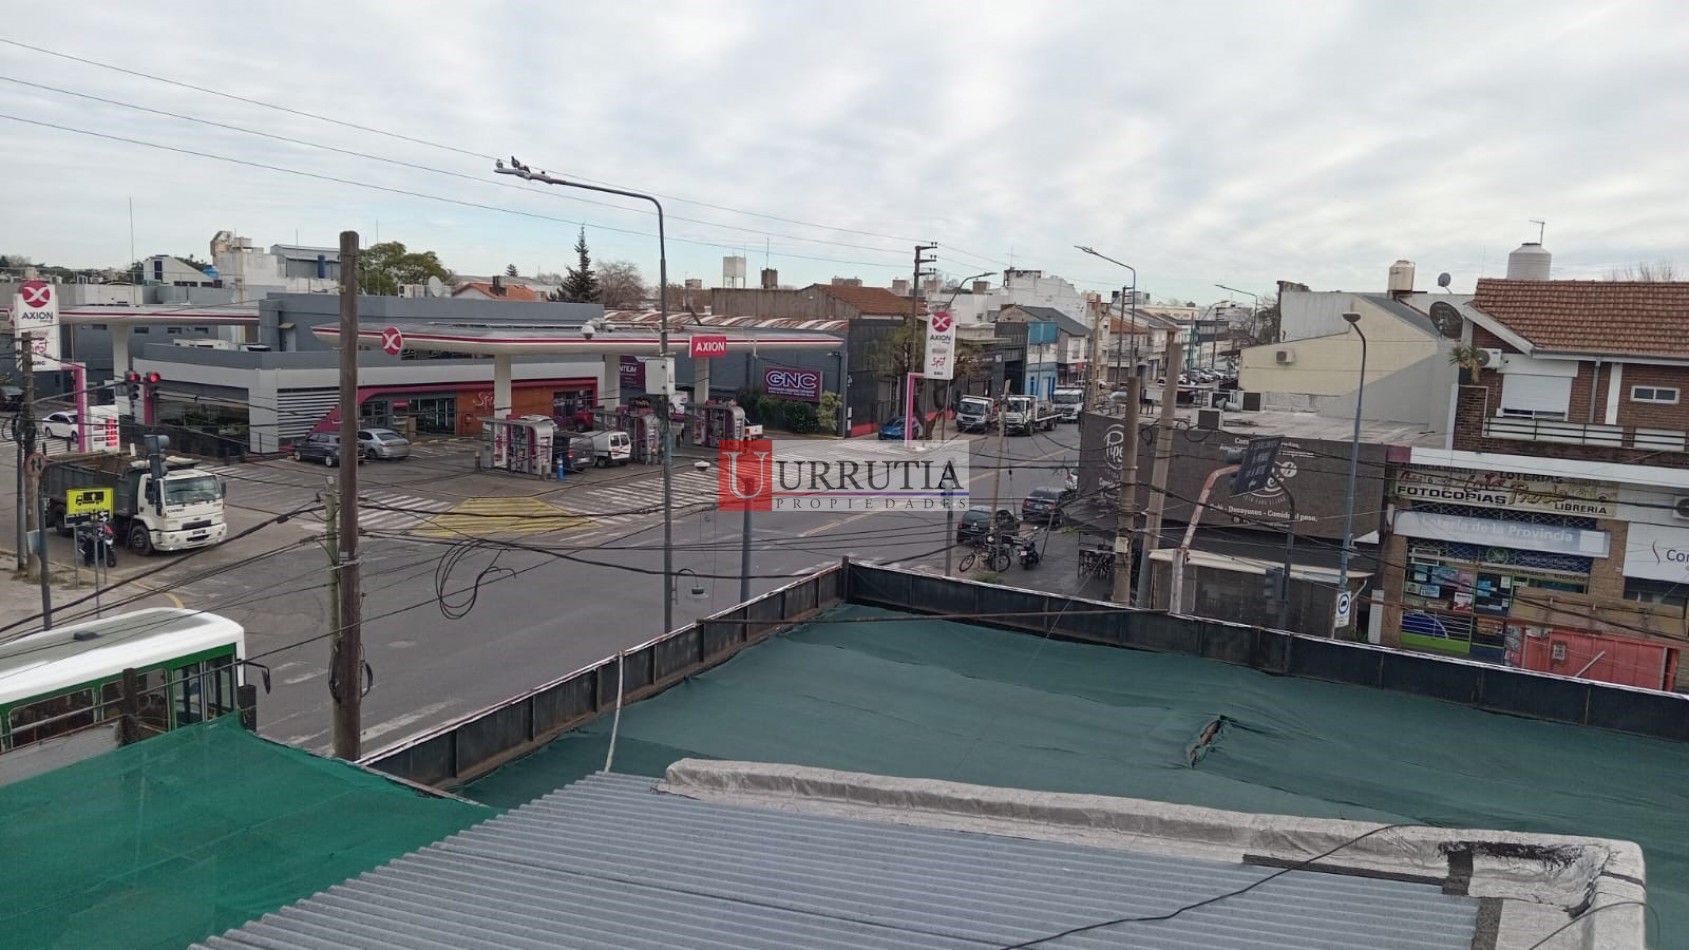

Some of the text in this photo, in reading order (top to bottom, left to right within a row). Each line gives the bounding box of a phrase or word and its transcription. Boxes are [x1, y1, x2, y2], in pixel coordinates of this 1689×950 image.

[21, 312, 54, 320] AXION
[695, 341, 725, 352] AXION
[766, 370, 817, 390] GNC
[1499, 471, 1563, 484] LOTERIAS
[1397, 486, 1507, 504] FOTOCOPIAS
[1268, 510, 1290, 519] Comid
[1554, 503, 1607, 515] LIBRERIA
[1493, 523, 1504, 534] la
[1509, 525, 1574, 542] Provincia
